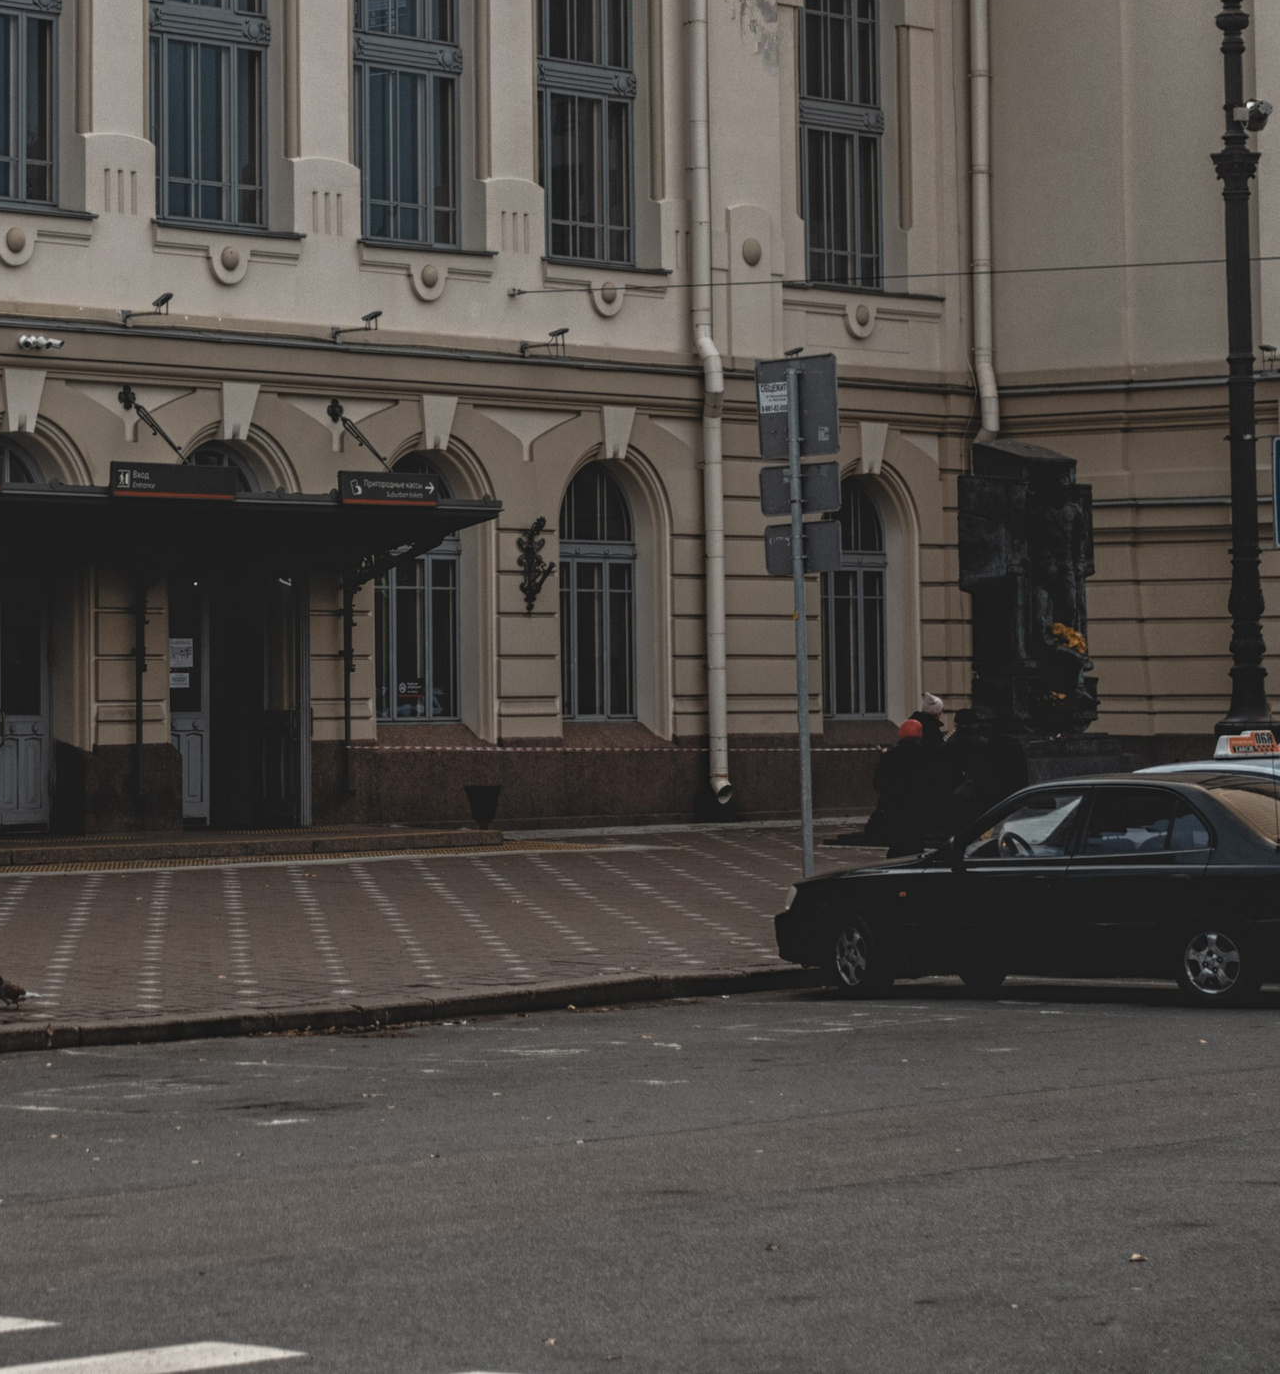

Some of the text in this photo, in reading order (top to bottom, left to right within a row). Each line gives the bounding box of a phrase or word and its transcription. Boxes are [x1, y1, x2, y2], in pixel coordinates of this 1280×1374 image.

[760, 383, 787, 394] ОБЩЕЖИТ
[132, 470, 150, 480] Вход
[132, 481, 156, 489] Entrance
[363, 479, 405, 489] Пригородные
[1254, 732, 1273, 744] 068
